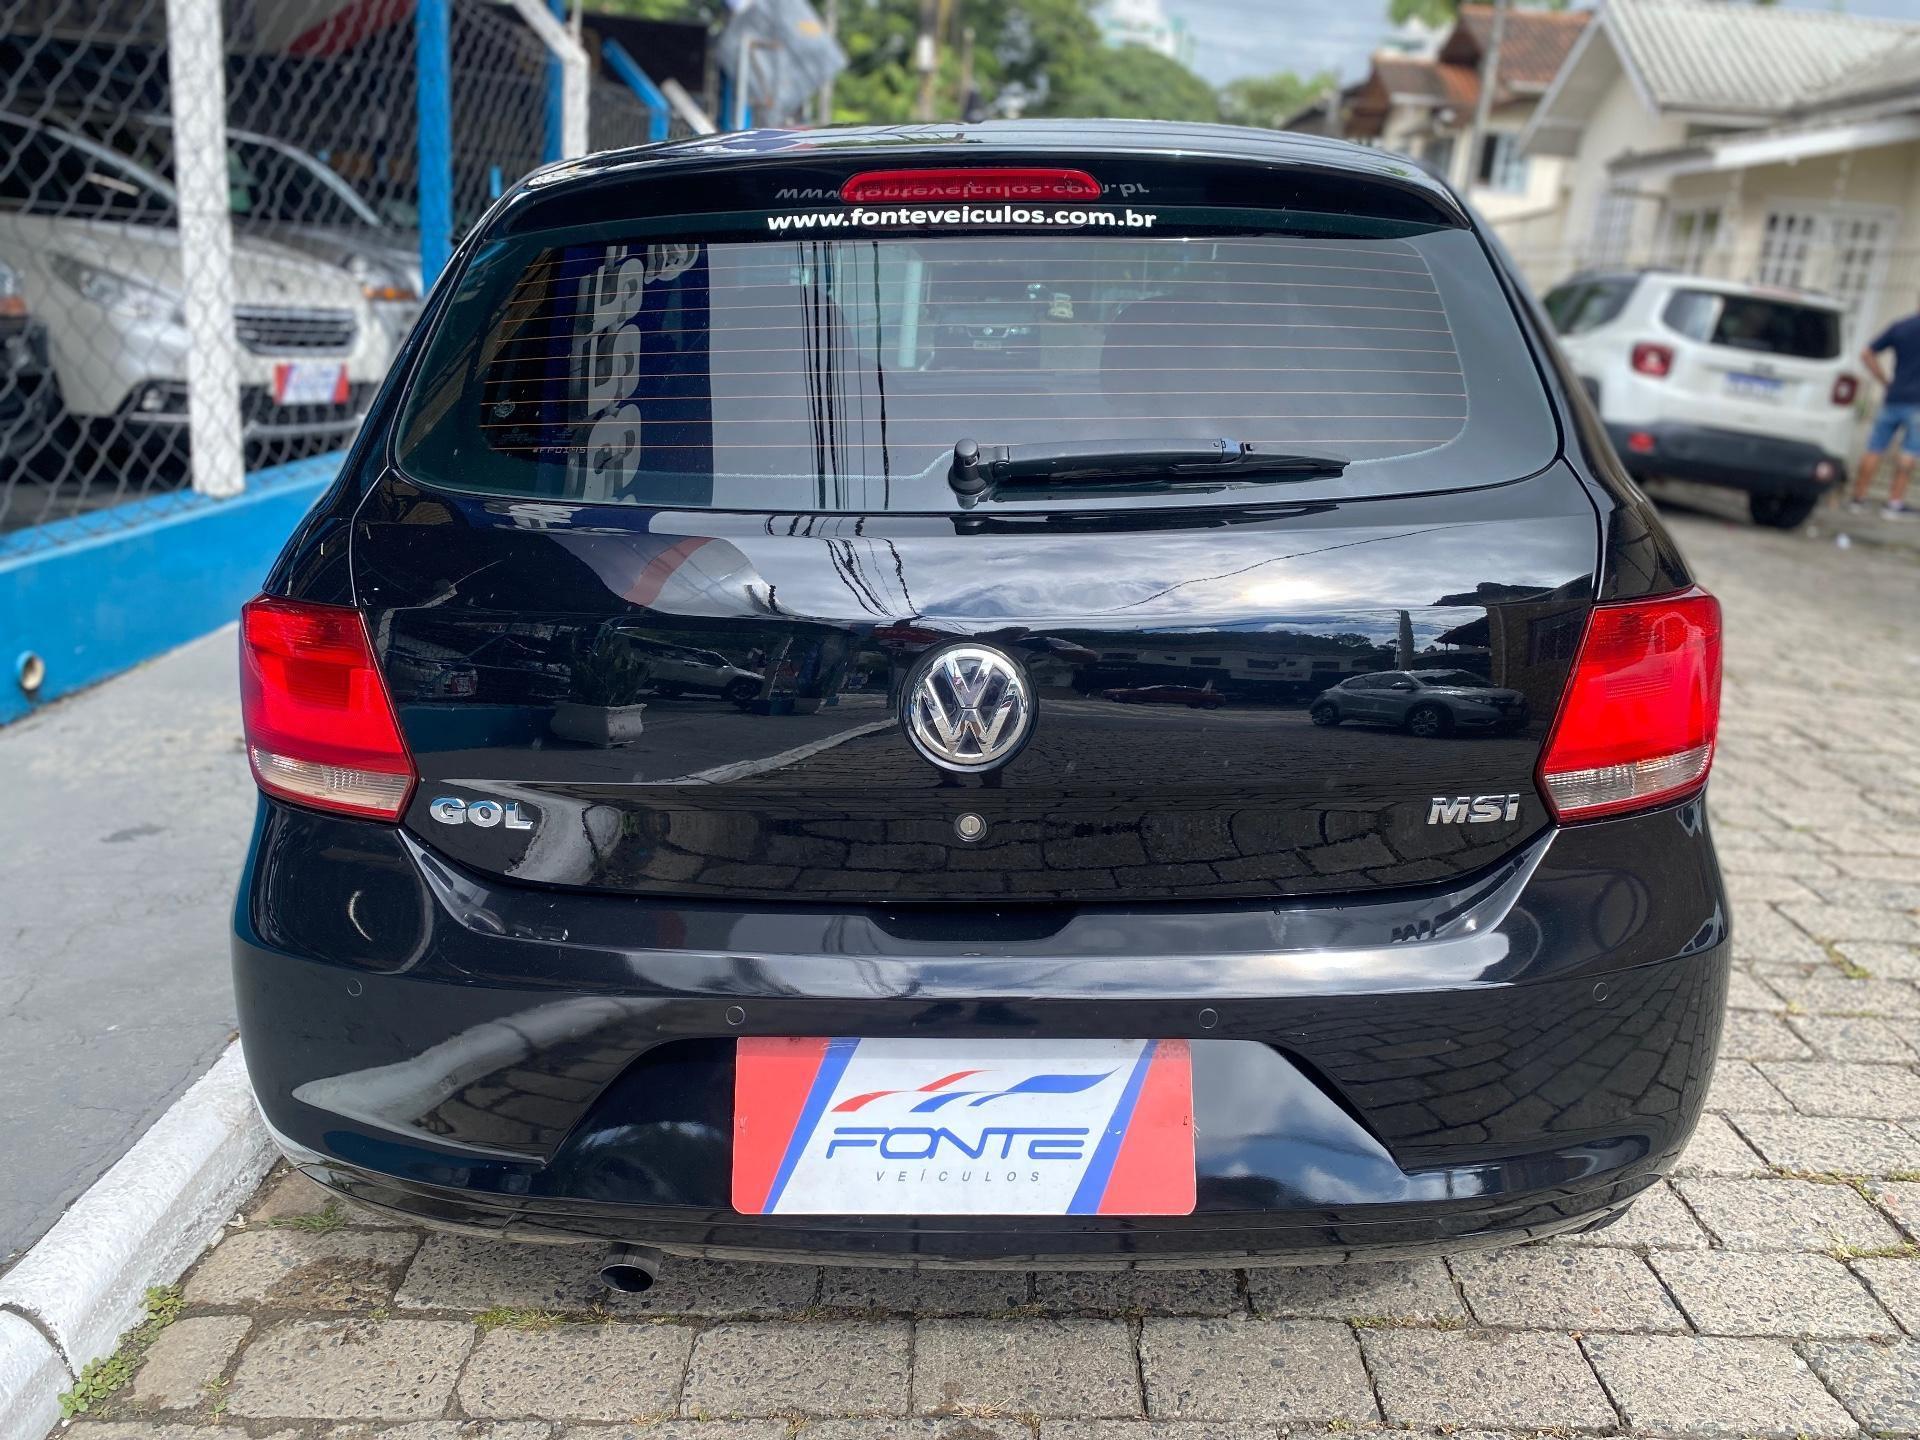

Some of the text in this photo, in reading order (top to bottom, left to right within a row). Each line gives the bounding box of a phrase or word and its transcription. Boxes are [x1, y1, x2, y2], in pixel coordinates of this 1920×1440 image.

[767, 205, 1157, 231] www.fonteveiculos.com.br
[429, 795, 533, 829] GOL
[825, 1127, 1091, 1160] FONTE
[875, 1169, 1041, 1184] VEÍCULOS
